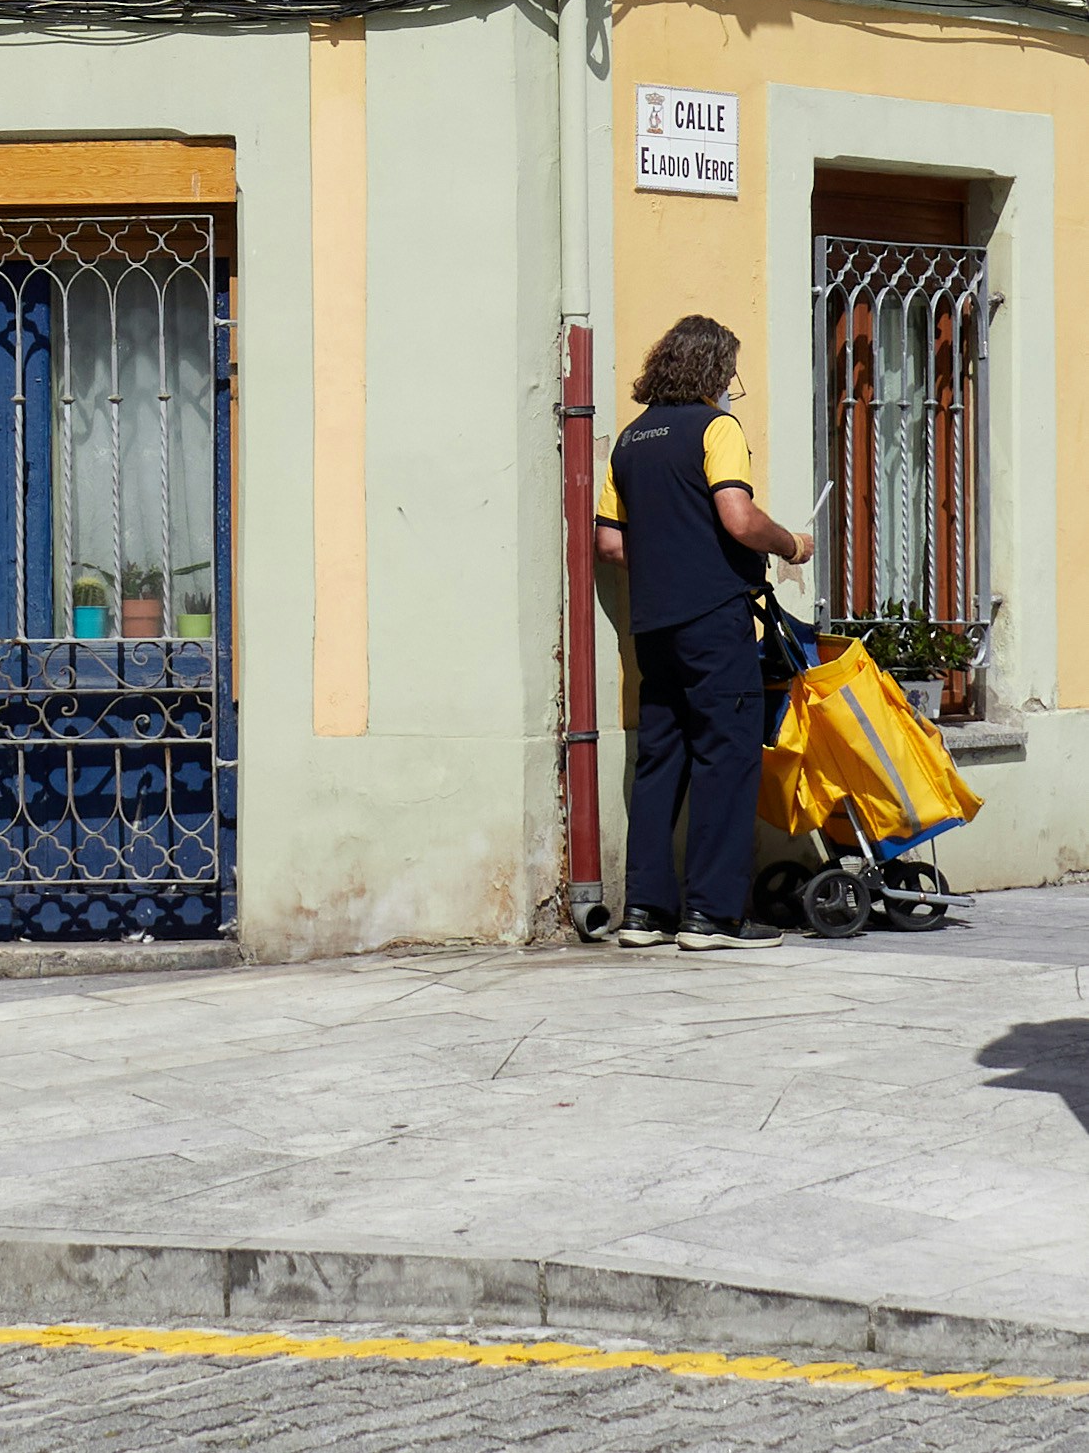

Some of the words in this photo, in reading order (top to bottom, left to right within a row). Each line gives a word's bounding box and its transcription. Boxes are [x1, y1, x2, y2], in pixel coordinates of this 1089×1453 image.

[675, 100, 725, 133] CALLE
[640, 146, 690, 179] ELADIO
[695, 151, 735, 183] VERDE
[631, 426, 670, 442] Correos
